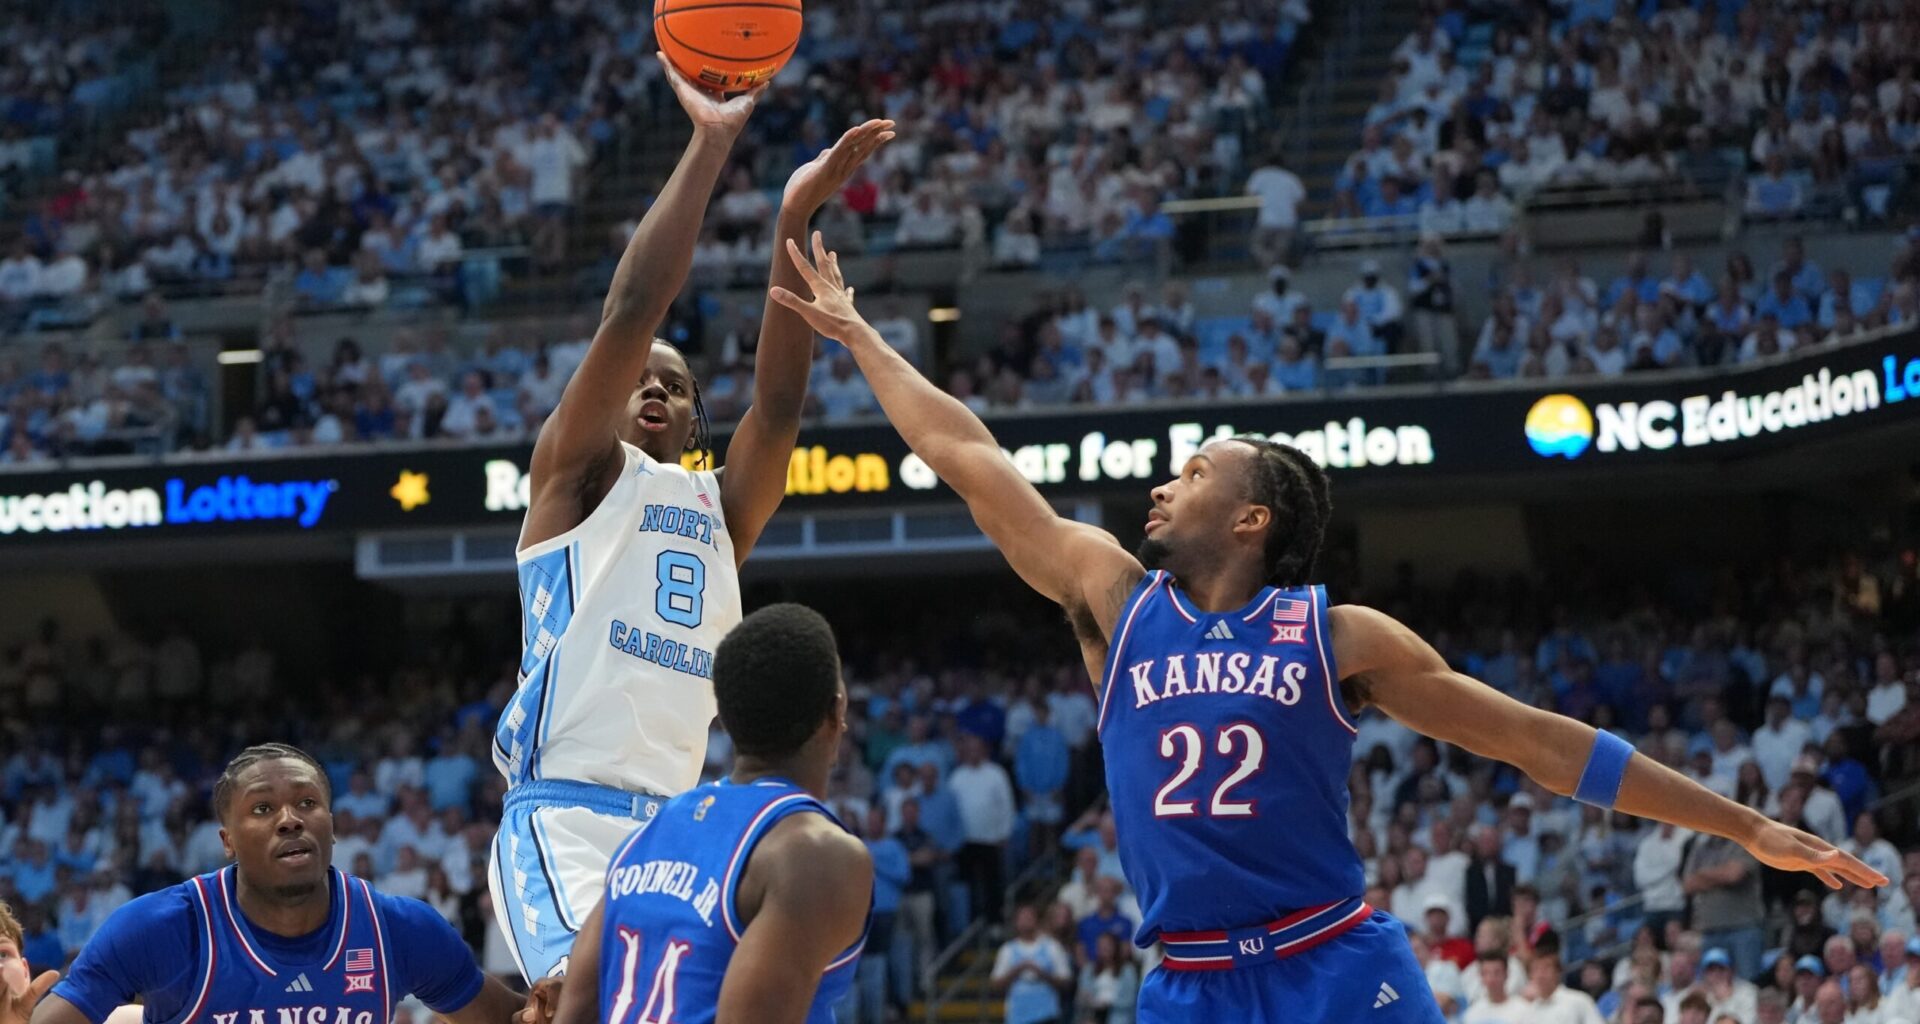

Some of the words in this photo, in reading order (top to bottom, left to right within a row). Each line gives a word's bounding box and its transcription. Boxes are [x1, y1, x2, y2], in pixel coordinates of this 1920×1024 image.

[1596, 400, 1679, 452] NC
[1681, 367, 1881, 447] Education
[1000, 443, 1072, 484] ar
[1079, 431, 1157, 481] for
[166, 475, 333, 528] Lottery
[639, 504, 721, 546] NORT
[656, 549, 705, 629] 8
[1271, 624, 1306, 643] XII
[1128, 652, 1307, 709] KANSAS
[1153, 722, 1267, 818] 22
[610, 860, 699, 901] COUNCIL
[692, 877, 720, 928] JR.
[1239, 937, 1264, 955] KU
[344, 973, 375, 993] XII
[609, 927, 691, 1024] 14
